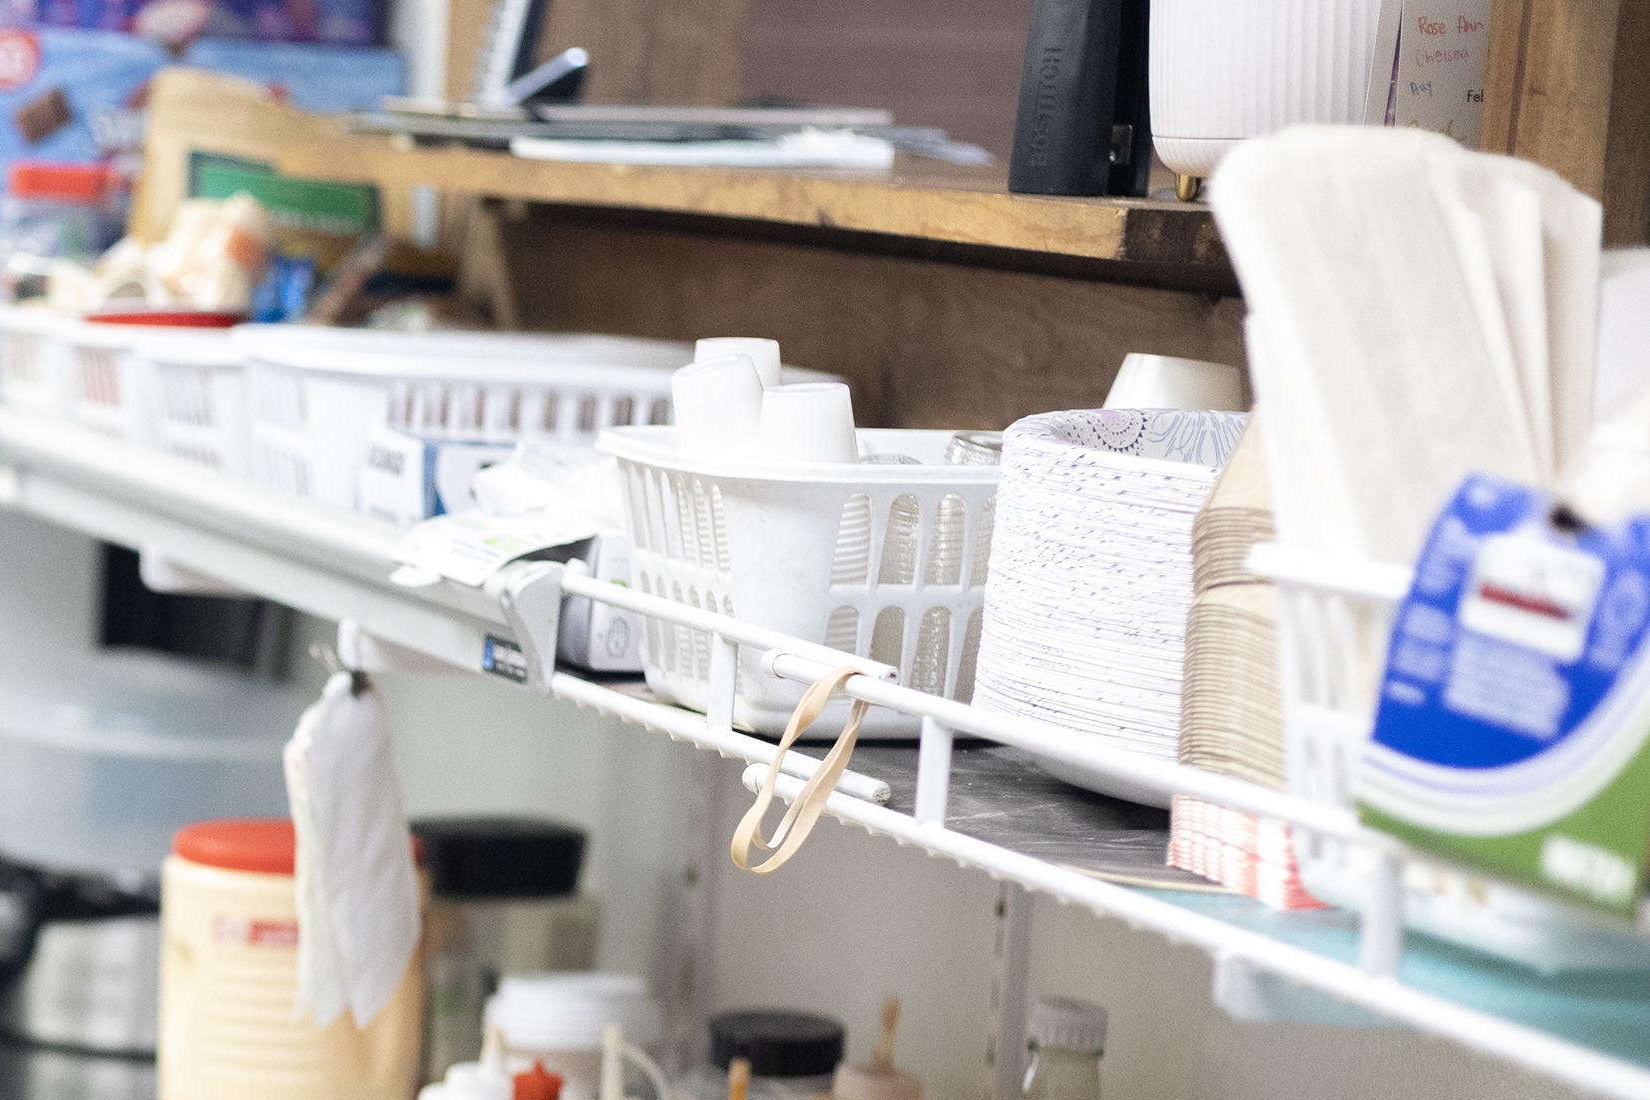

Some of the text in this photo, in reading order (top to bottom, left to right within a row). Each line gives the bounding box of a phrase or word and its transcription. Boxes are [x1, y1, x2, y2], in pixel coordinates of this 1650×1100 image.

[1418, 15, 1484, 35] Rose Ann
[1416, 48, 1469, 67] Chelsea
[1030, 48, 1062, 166] BOSTITCH
